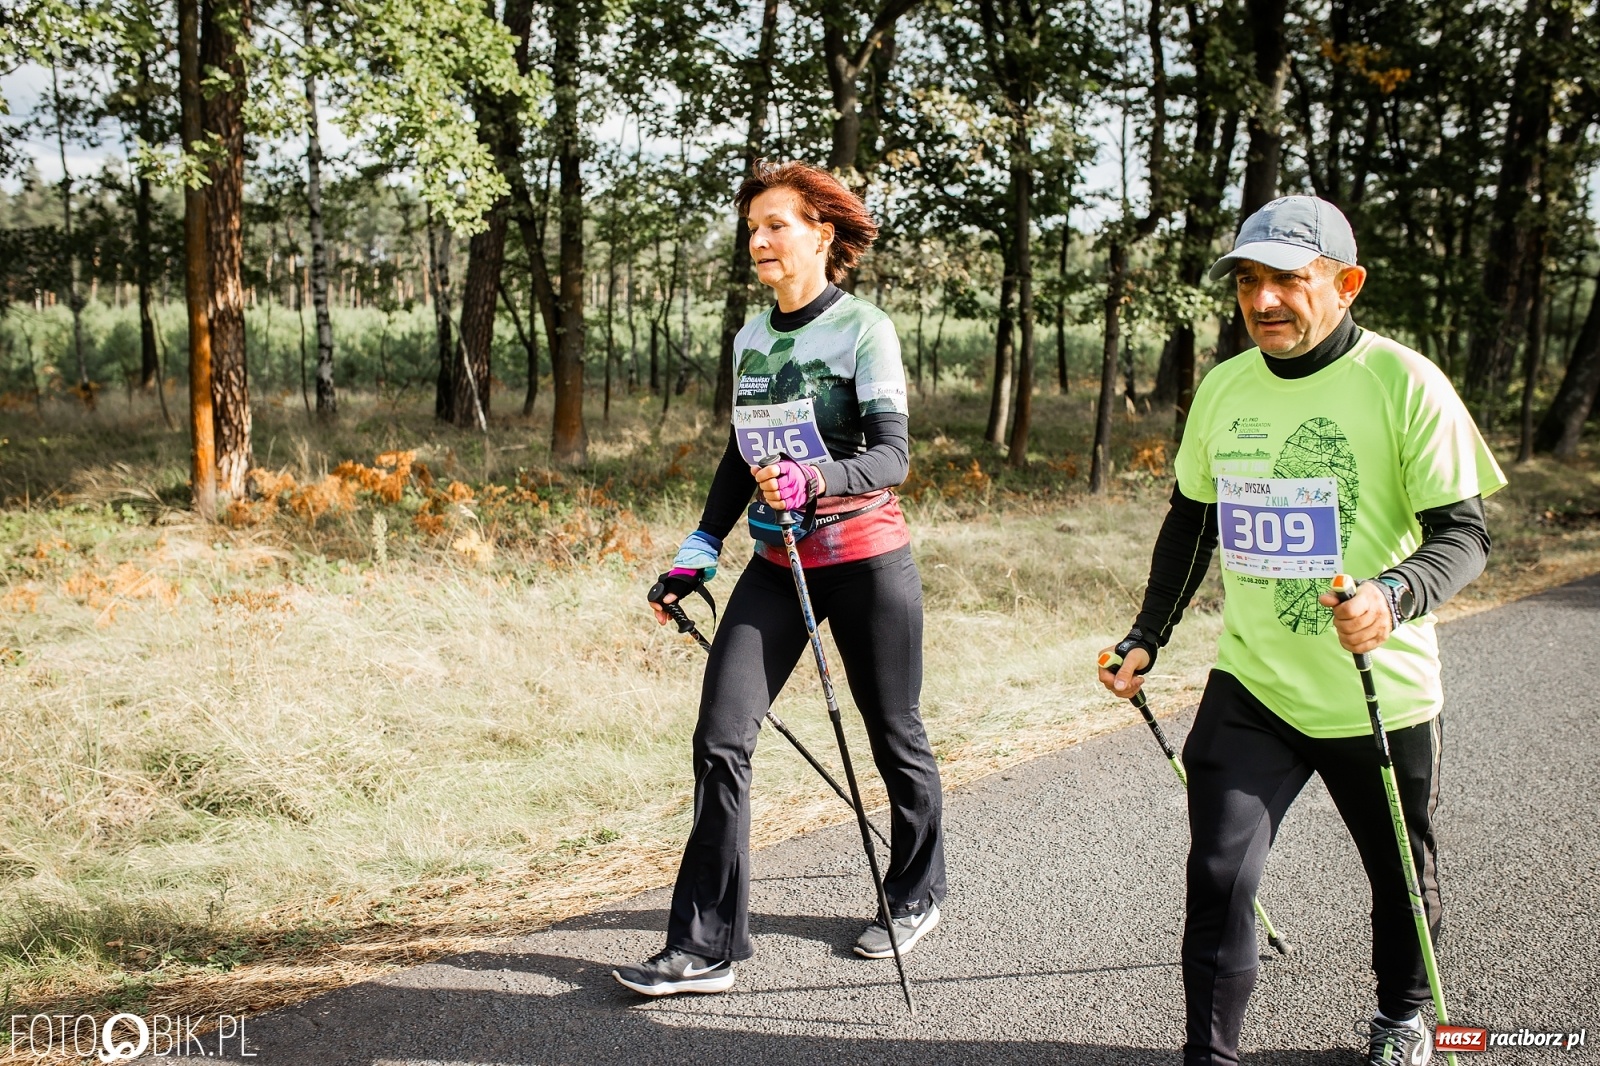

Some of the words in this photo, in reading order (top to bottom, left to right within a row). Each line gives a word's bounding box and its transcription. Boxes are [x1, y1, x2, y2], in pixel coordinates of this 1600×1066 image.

[752, 409, 771, 419] DYSZKA
[747, 428, 809, 462] 346
[1245, 482, 1271, 494] DYSZKA
[1265, 496, 1271, 506] Z
[1271, 496, 1289, 507] KIJA
[1231, 508, 1315, 553] 309
